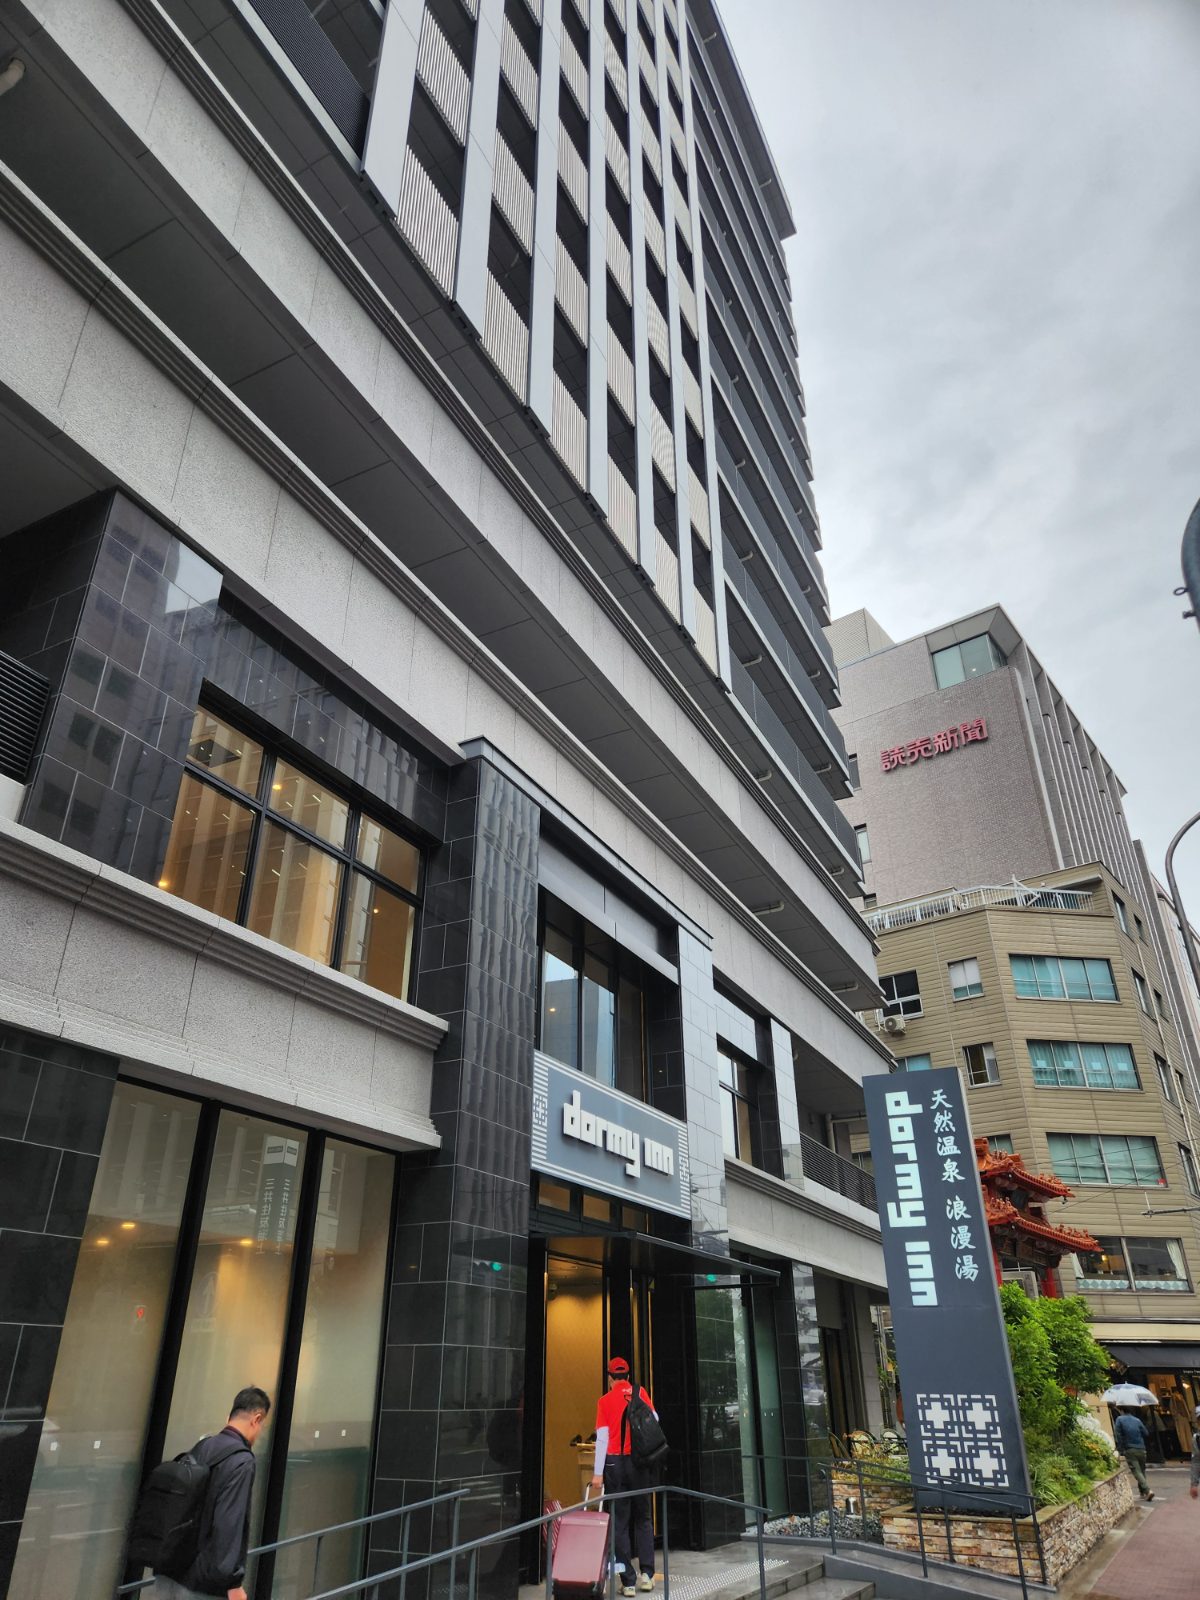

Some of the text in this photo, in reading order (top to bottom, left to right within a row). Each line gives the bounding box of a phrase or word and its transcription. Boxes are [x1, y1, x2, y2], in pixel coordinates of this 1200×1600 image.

[879, 717, 989, 772] 読売新聞
[563, 1089, 674, 1179] dormy inn
[885, 1090, 939, 1307] dormy inn
[929, 1088, 980, 1283] 天然温泉 浪漫湯
